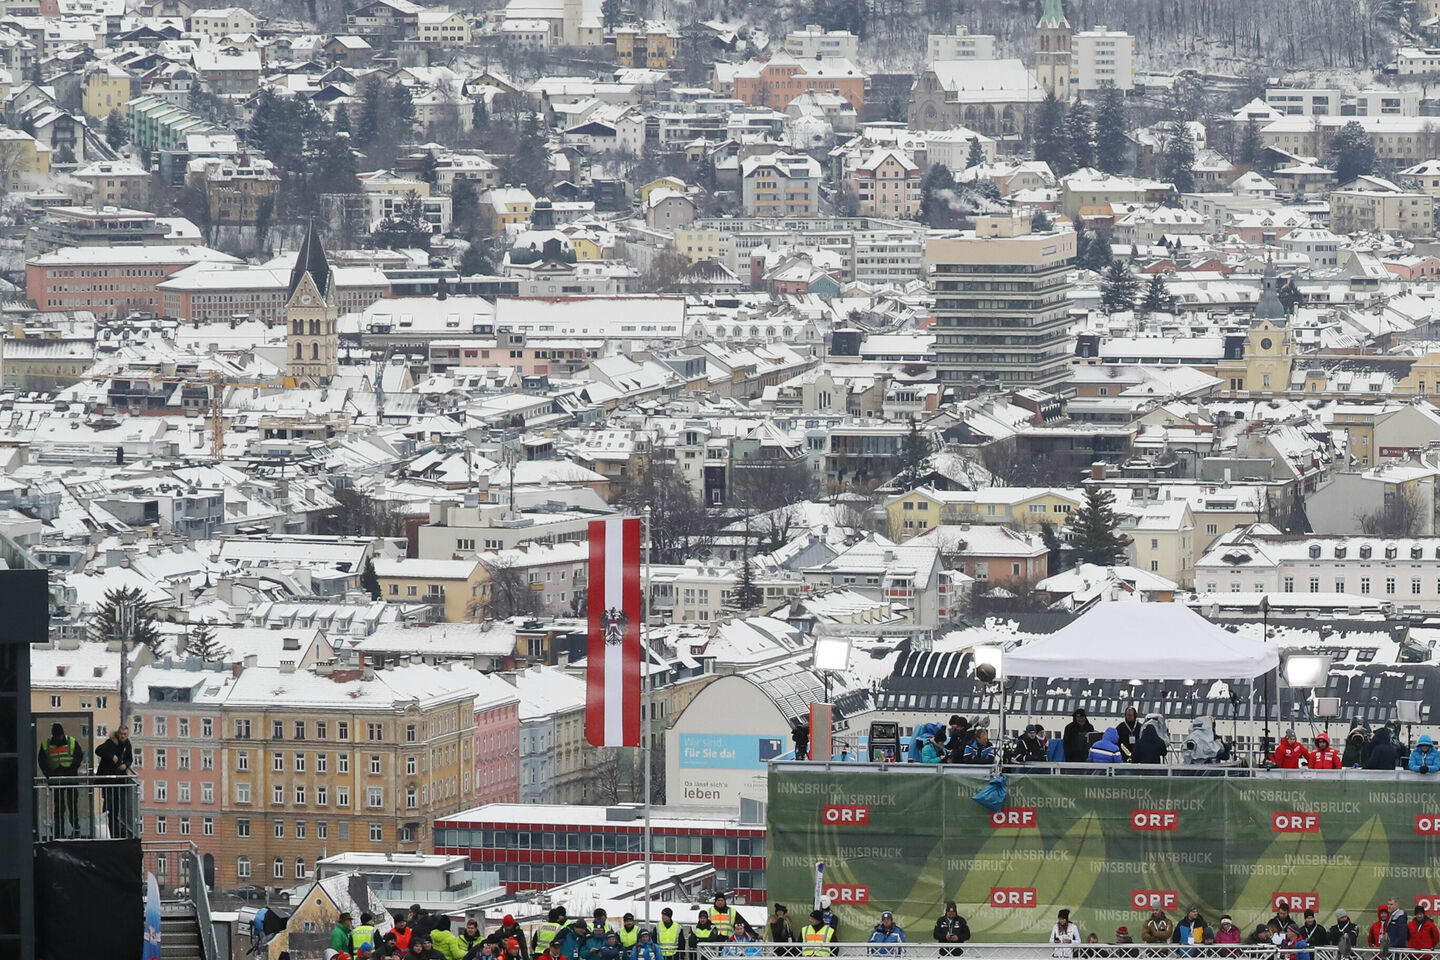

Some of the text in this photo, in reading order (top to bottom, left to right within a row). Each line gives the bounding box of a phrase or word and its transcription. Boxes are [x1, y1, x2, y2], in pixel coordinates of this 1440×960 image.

[685, 749, 736, 759] für Sie da!
[684, 788, 720, 799] leben
[1085, 788, 1152, 799] INNSBRUCK
[1240, 790, 1307, 801] INNSBRUCK
[1369, 792, 1436, 803] INNSBRUCK
[1011, 797, 1076, 809] INNSBRUCK
[1138, 799, 1204, 810] INNSBRUCK
[1293, 802, 1360, 813] INNSBRUCK
[826, 809, 866, 821] ORF
[994, 812, 1033, 823] ORF
[1134, 814, 1174, 826] ORF
[1276, 816, 1316, 828] ORF
[826, 888, 866, 900] ORF
[994, 892, 1033, 904] ORF
